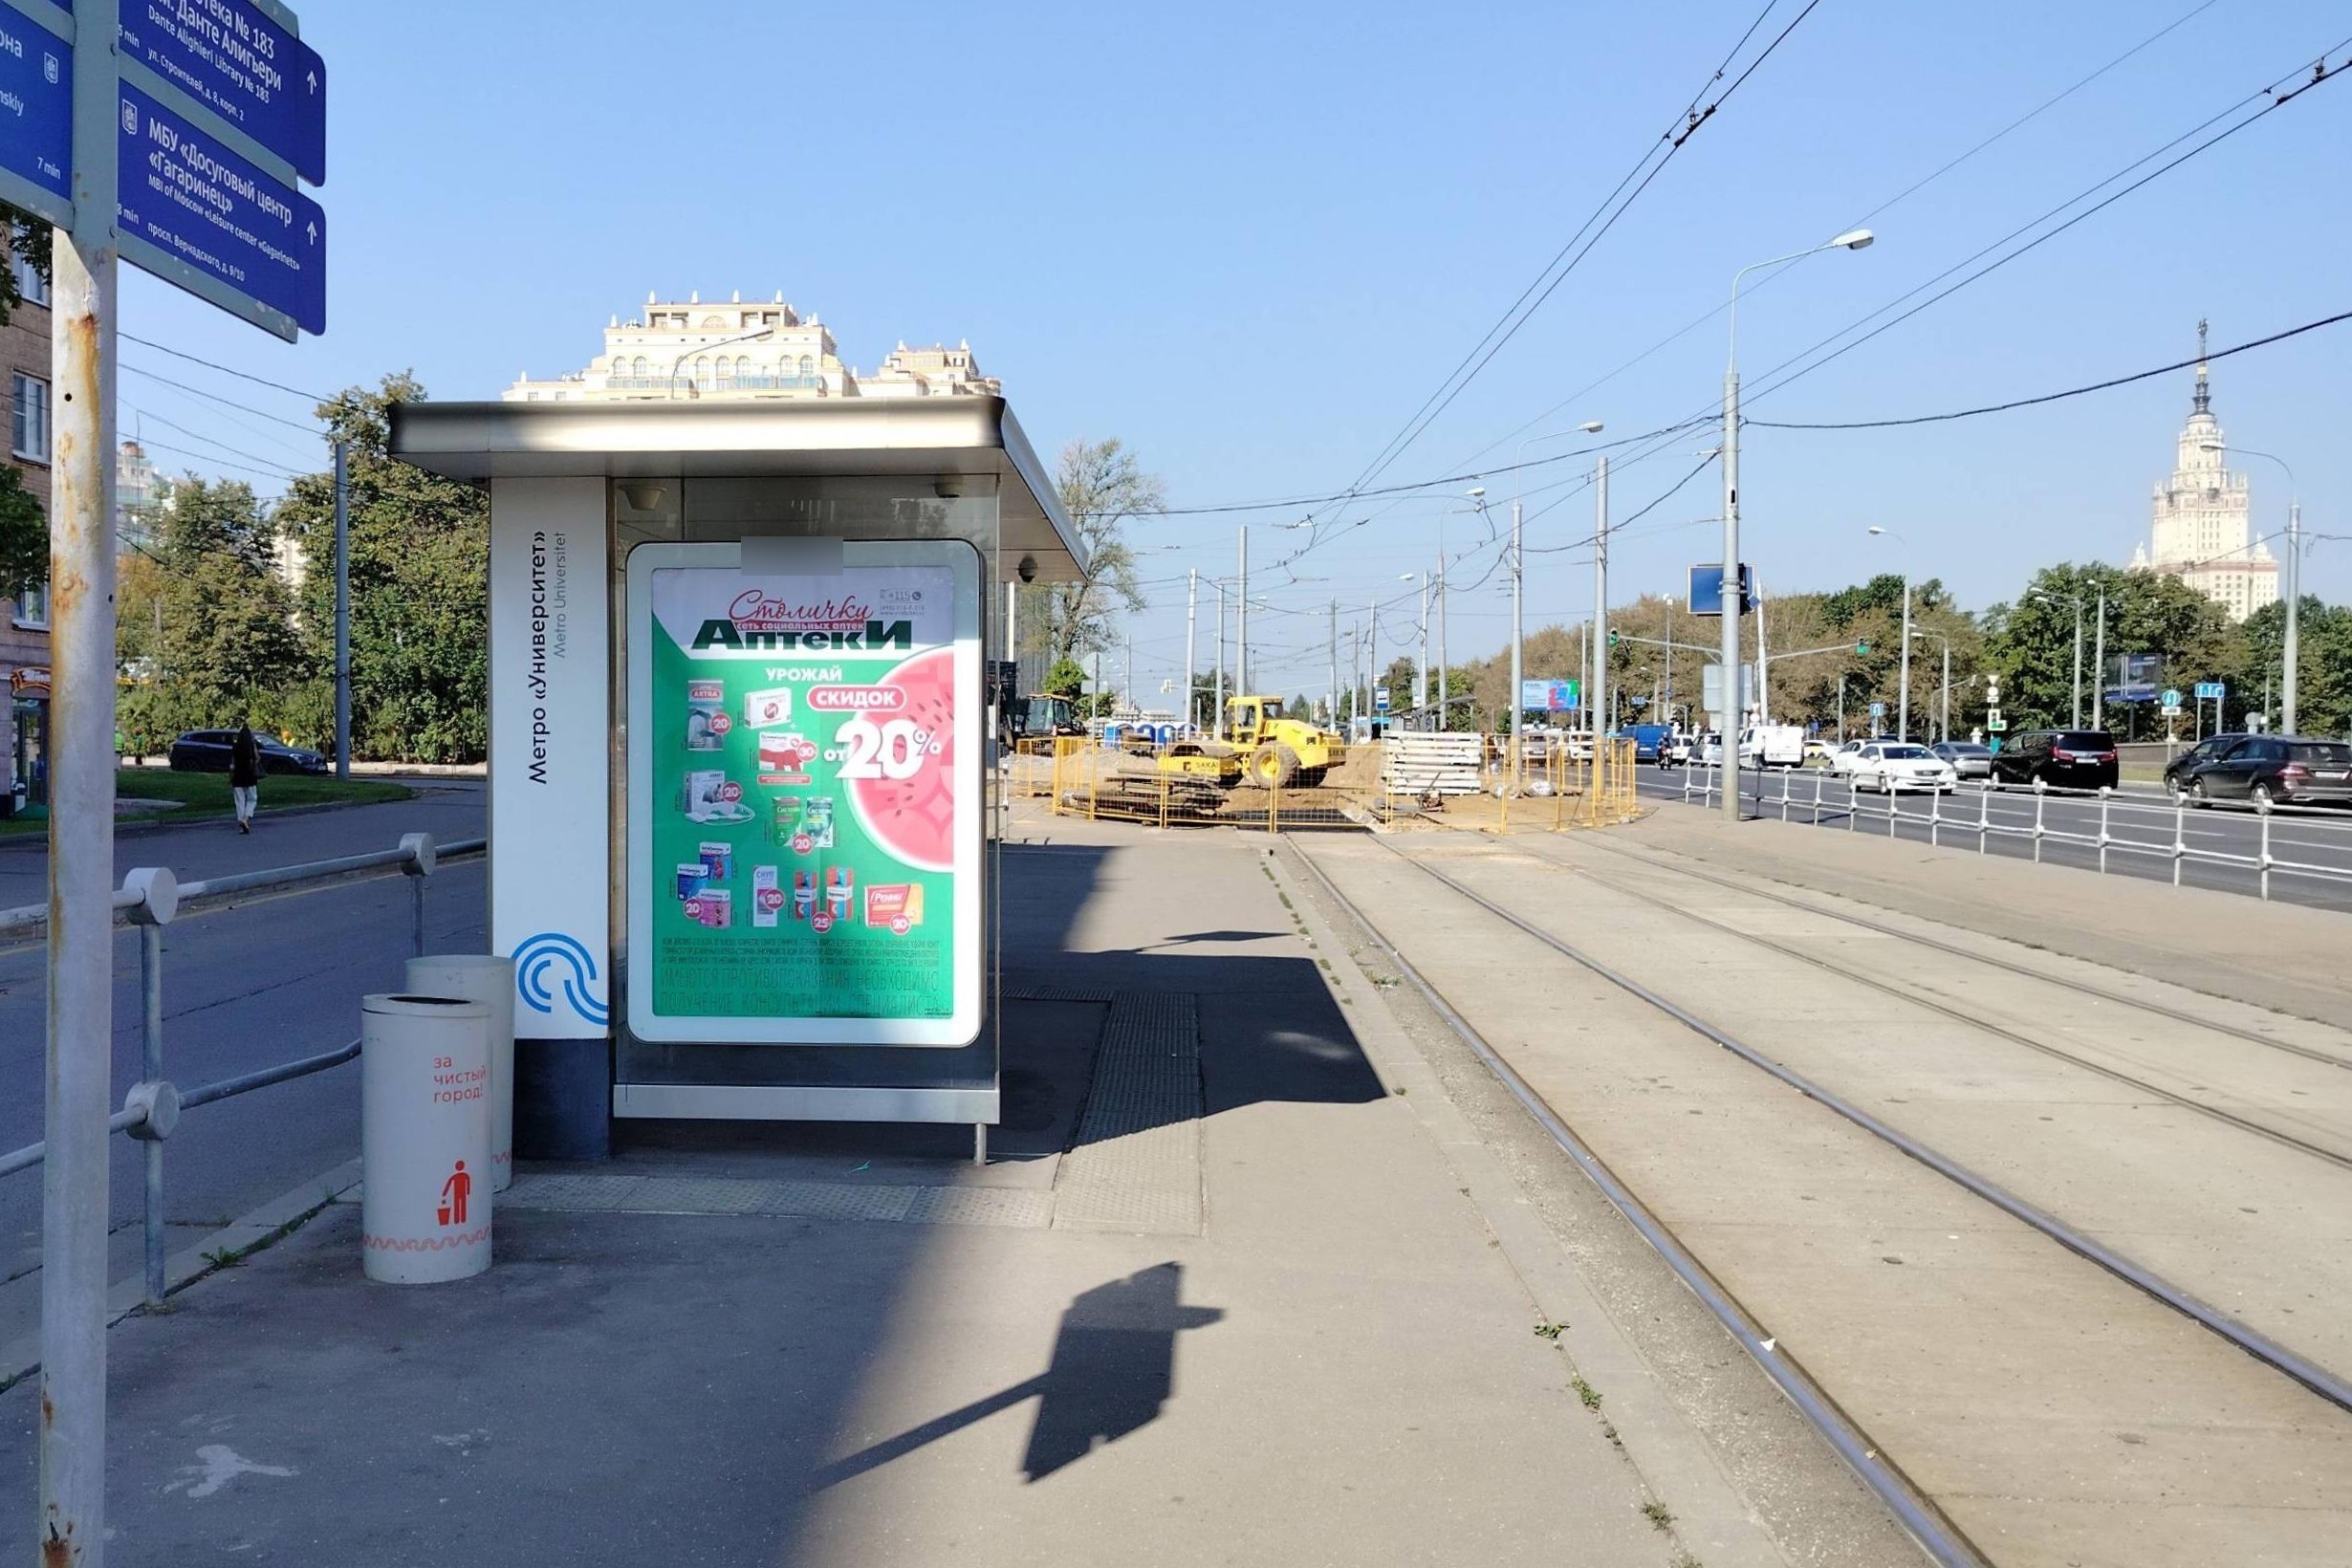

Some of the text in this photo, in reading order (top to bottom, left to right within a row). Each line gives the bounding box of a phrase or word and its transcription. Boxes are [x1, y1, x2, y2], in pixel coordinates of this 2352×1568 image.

[123, 30, 141, 49] min
[234, 11, 250, 41] №
[252, 28, 275, 60] 183
[147, 4, 176, 36] Dante
[176, 27, 213, 63] Alighieri
[214, 54, 244, 88] Library
[255, 86, 270, 104] 183
[176, 0, 282, 92] Данте Алигьери
[37, 156, 61, 180] 7 min
[148, 117, 293, 229] МБУ «Досуговый центр
[148, 150, 234, 215] «Гагаринец»
[122, 207, 140, 226] min
[147, 173, 163, 193] MBI
[163, 182, 174, 198] of
[174, 189, 204, 216] Moscow
[234, 226, 258, 247] center
[147, 222, 173, 245] просп.
[554, 532, 567, 659] Metro Universitet
[729, 589, 875, 621] Столички
[736, 621, 864, 631] сеть социальных аптек
[528, 530, 551, 785] Метро «Университет»
[766, 664, 842, 682] УРОЖАЙ
[816, 688, 897, 708] СКИДОК
[823, 749, 845, 763] от
[724, 786, 740, 797] 20
[795, 838, 811, 849] 20
[686, 903, 700, 914] 20
[766, 893, 783, 904] 20
[813, 917, 830, 928] 25
[892, 918, 908, 930] 20
[433, 1056, 452, 1069] за
[433, 1065, 488, 1085] чистый
